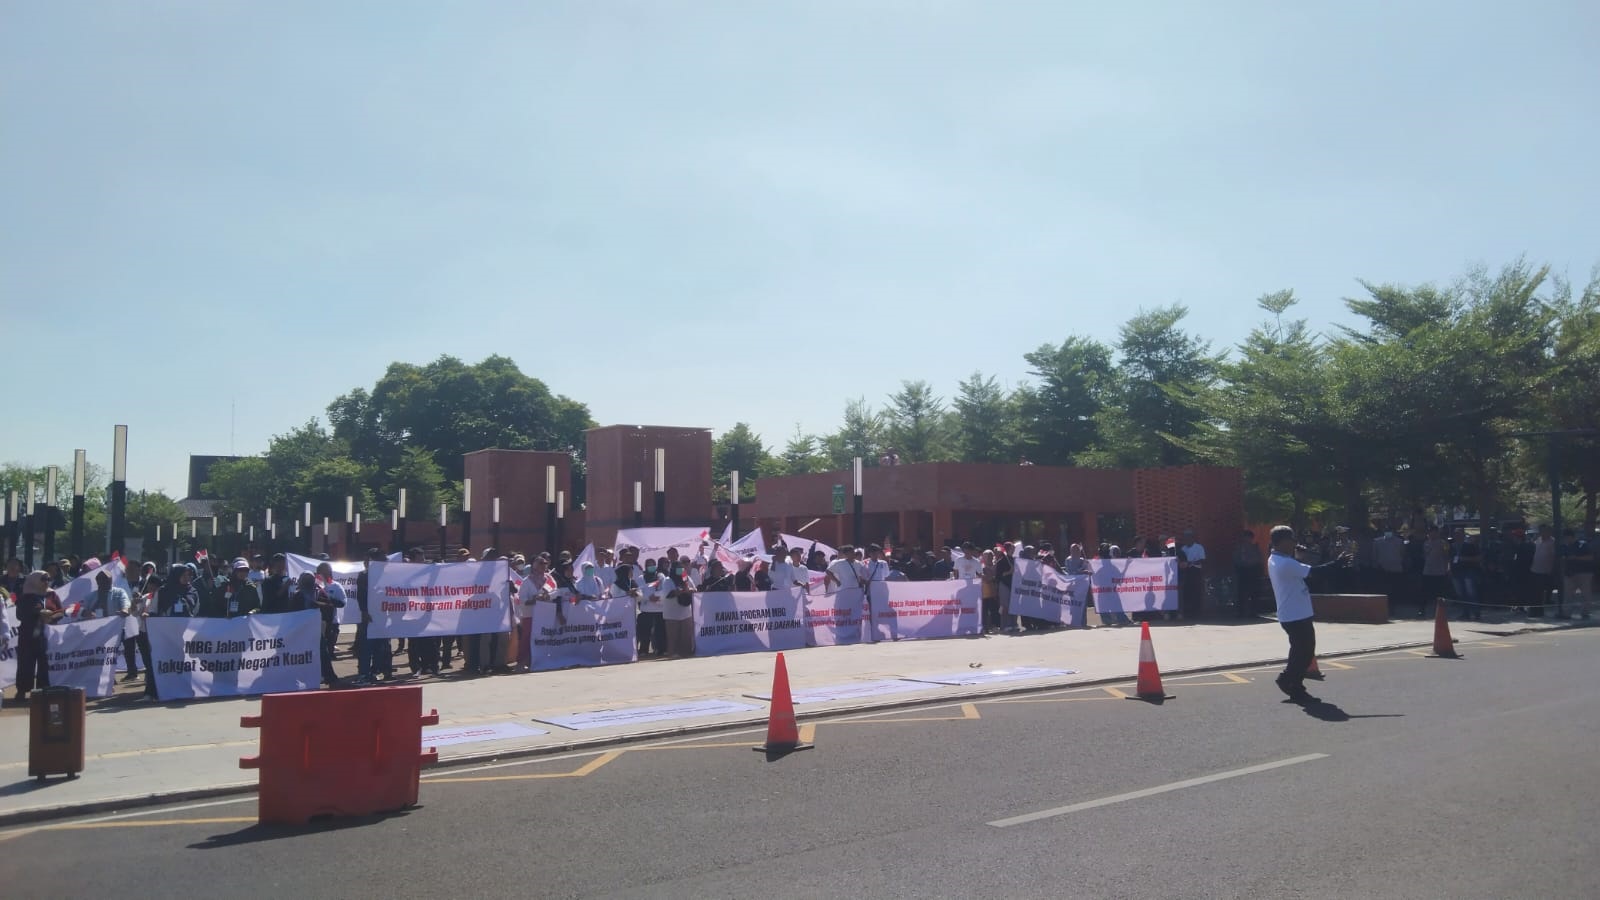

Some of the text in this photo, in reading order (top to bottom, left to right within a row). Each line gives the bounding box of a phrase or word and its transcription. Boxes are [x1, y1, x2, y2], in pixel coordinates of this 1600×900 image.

[385, 584, 490, 597] Hukum Mati Koruptor
[382, 598, 492, 612] Dana Program Rakyat!
[715, 610, 739, 621] KAWAL
[740, 608, 771, 621] PROGRAM
[700, 626, 716, 637] DARI
[716, 625, 738, 635] PUSAT
[738, 622, 765, 633] SAMPAI
[185, 637, 286, 654] MBG Jalan Terus.
[199, 658, 235, 673] Sehat
[238, 655, 280, 672] Negara
[282, 651, 313, 666] Kuat!
